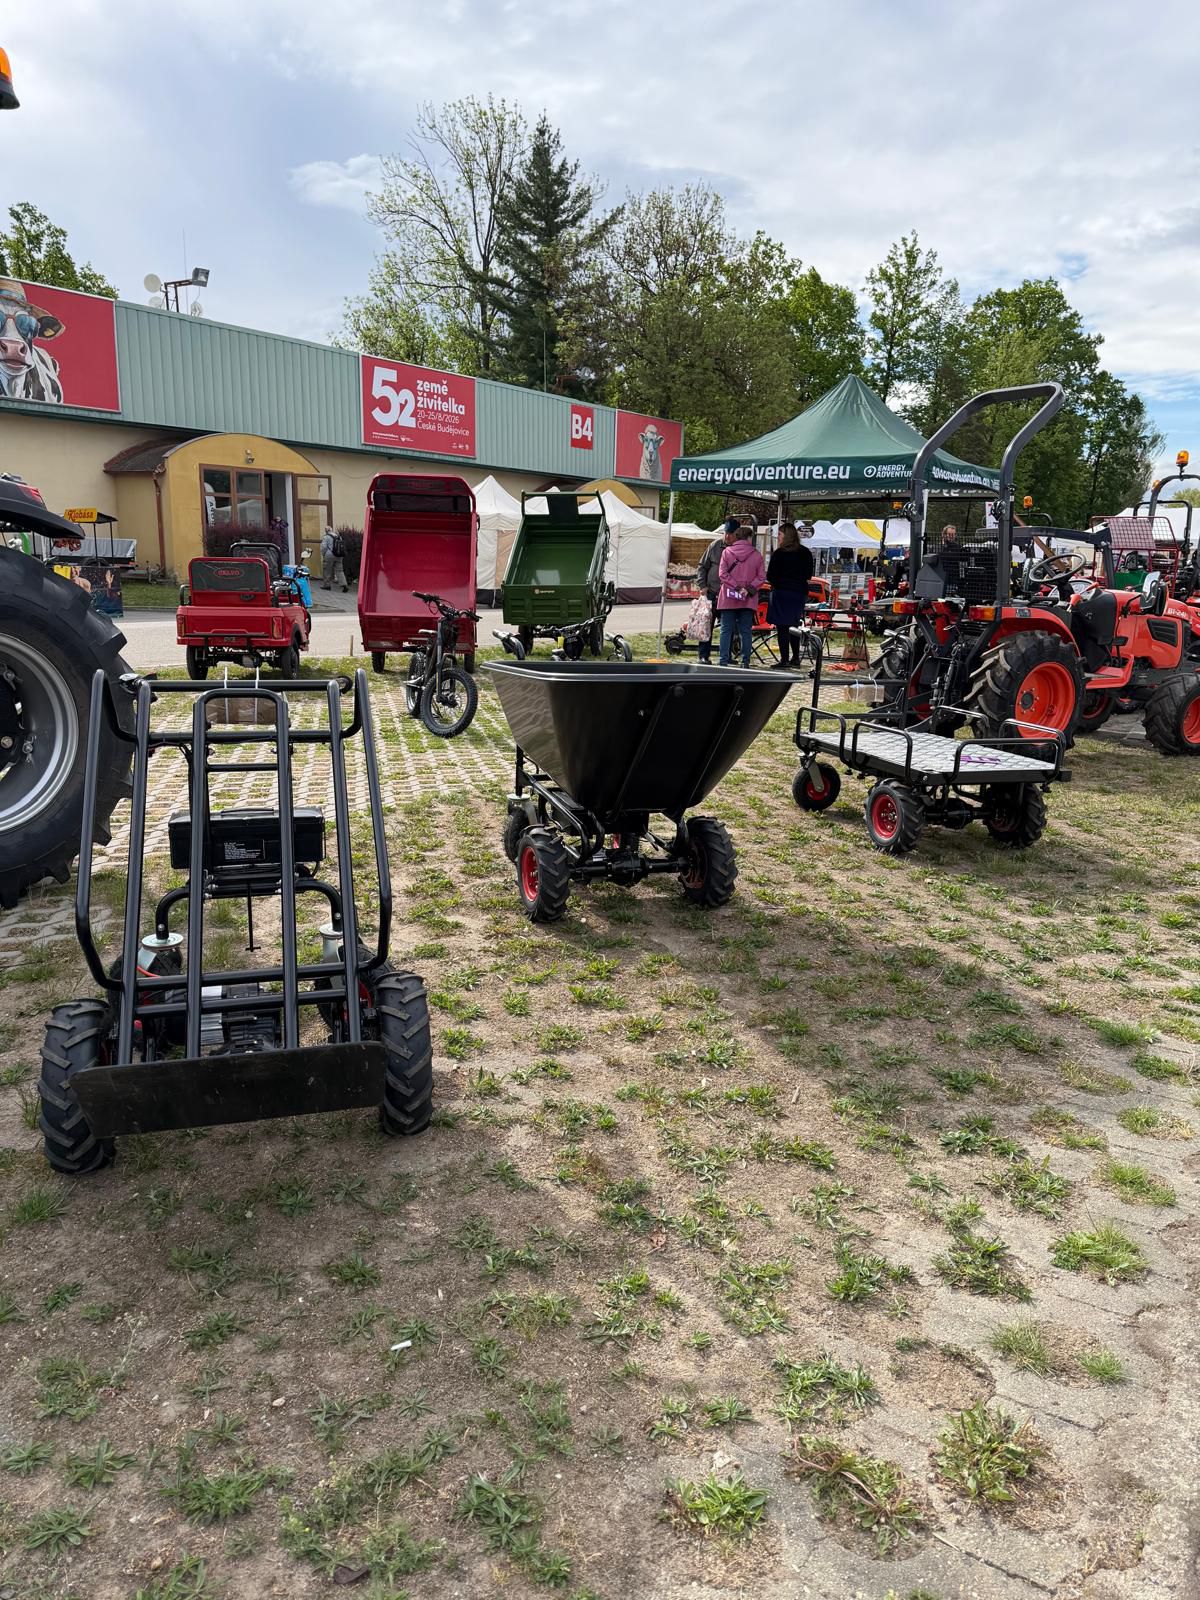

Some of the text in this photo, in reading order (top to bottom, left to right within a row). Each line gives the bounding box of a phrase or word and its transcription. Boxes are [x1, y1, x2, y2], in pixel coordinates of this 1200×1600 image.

[372, 366, 416, 428] 52
[416, 379, 448, 396] země
[416, 391, 466, 415] živitelka
[416, 409, 460, 424] 20-25/8/2026
[417, 418, 470, 436] České Budějovice
[572, 413, 593, 442] B4
[678, 463, 851, 484] energyadventure.eu
[875, 470, 913, 478] ADVENTU
